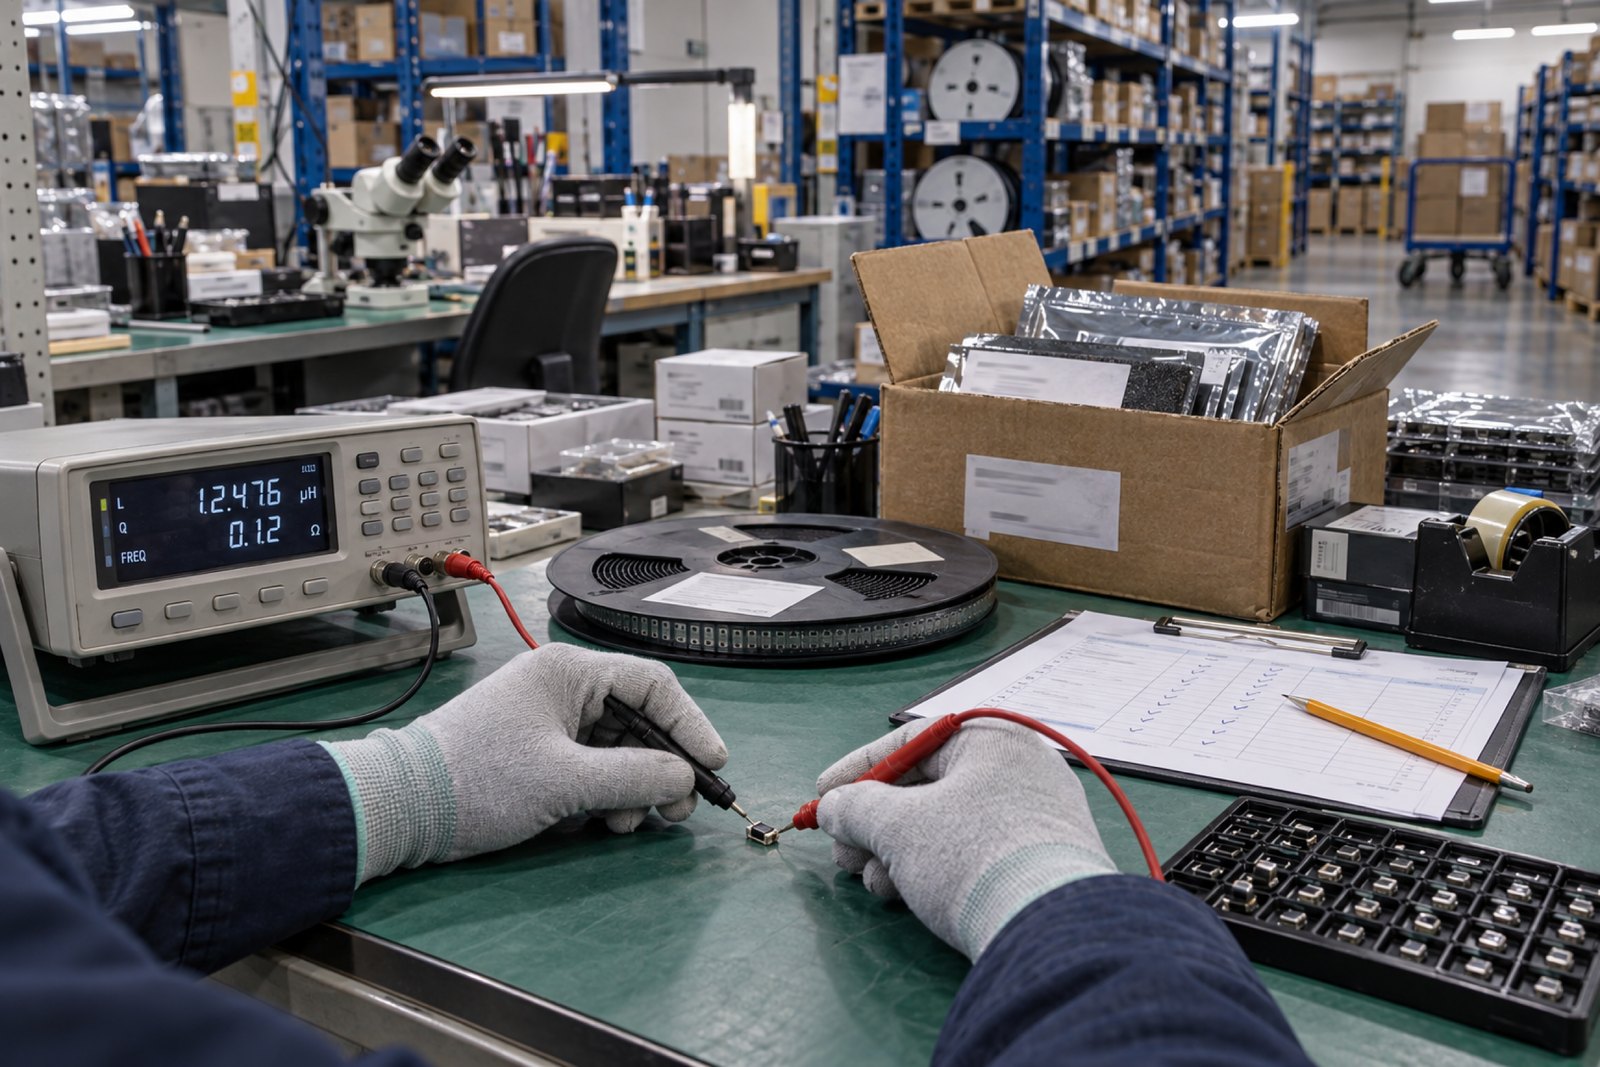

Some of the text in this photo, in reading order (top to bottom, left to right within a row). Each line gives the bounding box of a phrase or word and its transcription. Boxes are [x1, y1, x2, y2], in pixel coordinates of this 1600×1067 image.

[117, 498, 124, 510] L
[119, 522, 127, 534] Q
[310, 523, 321, 536] Ω
[121, 550, 146, 564] FREQ
